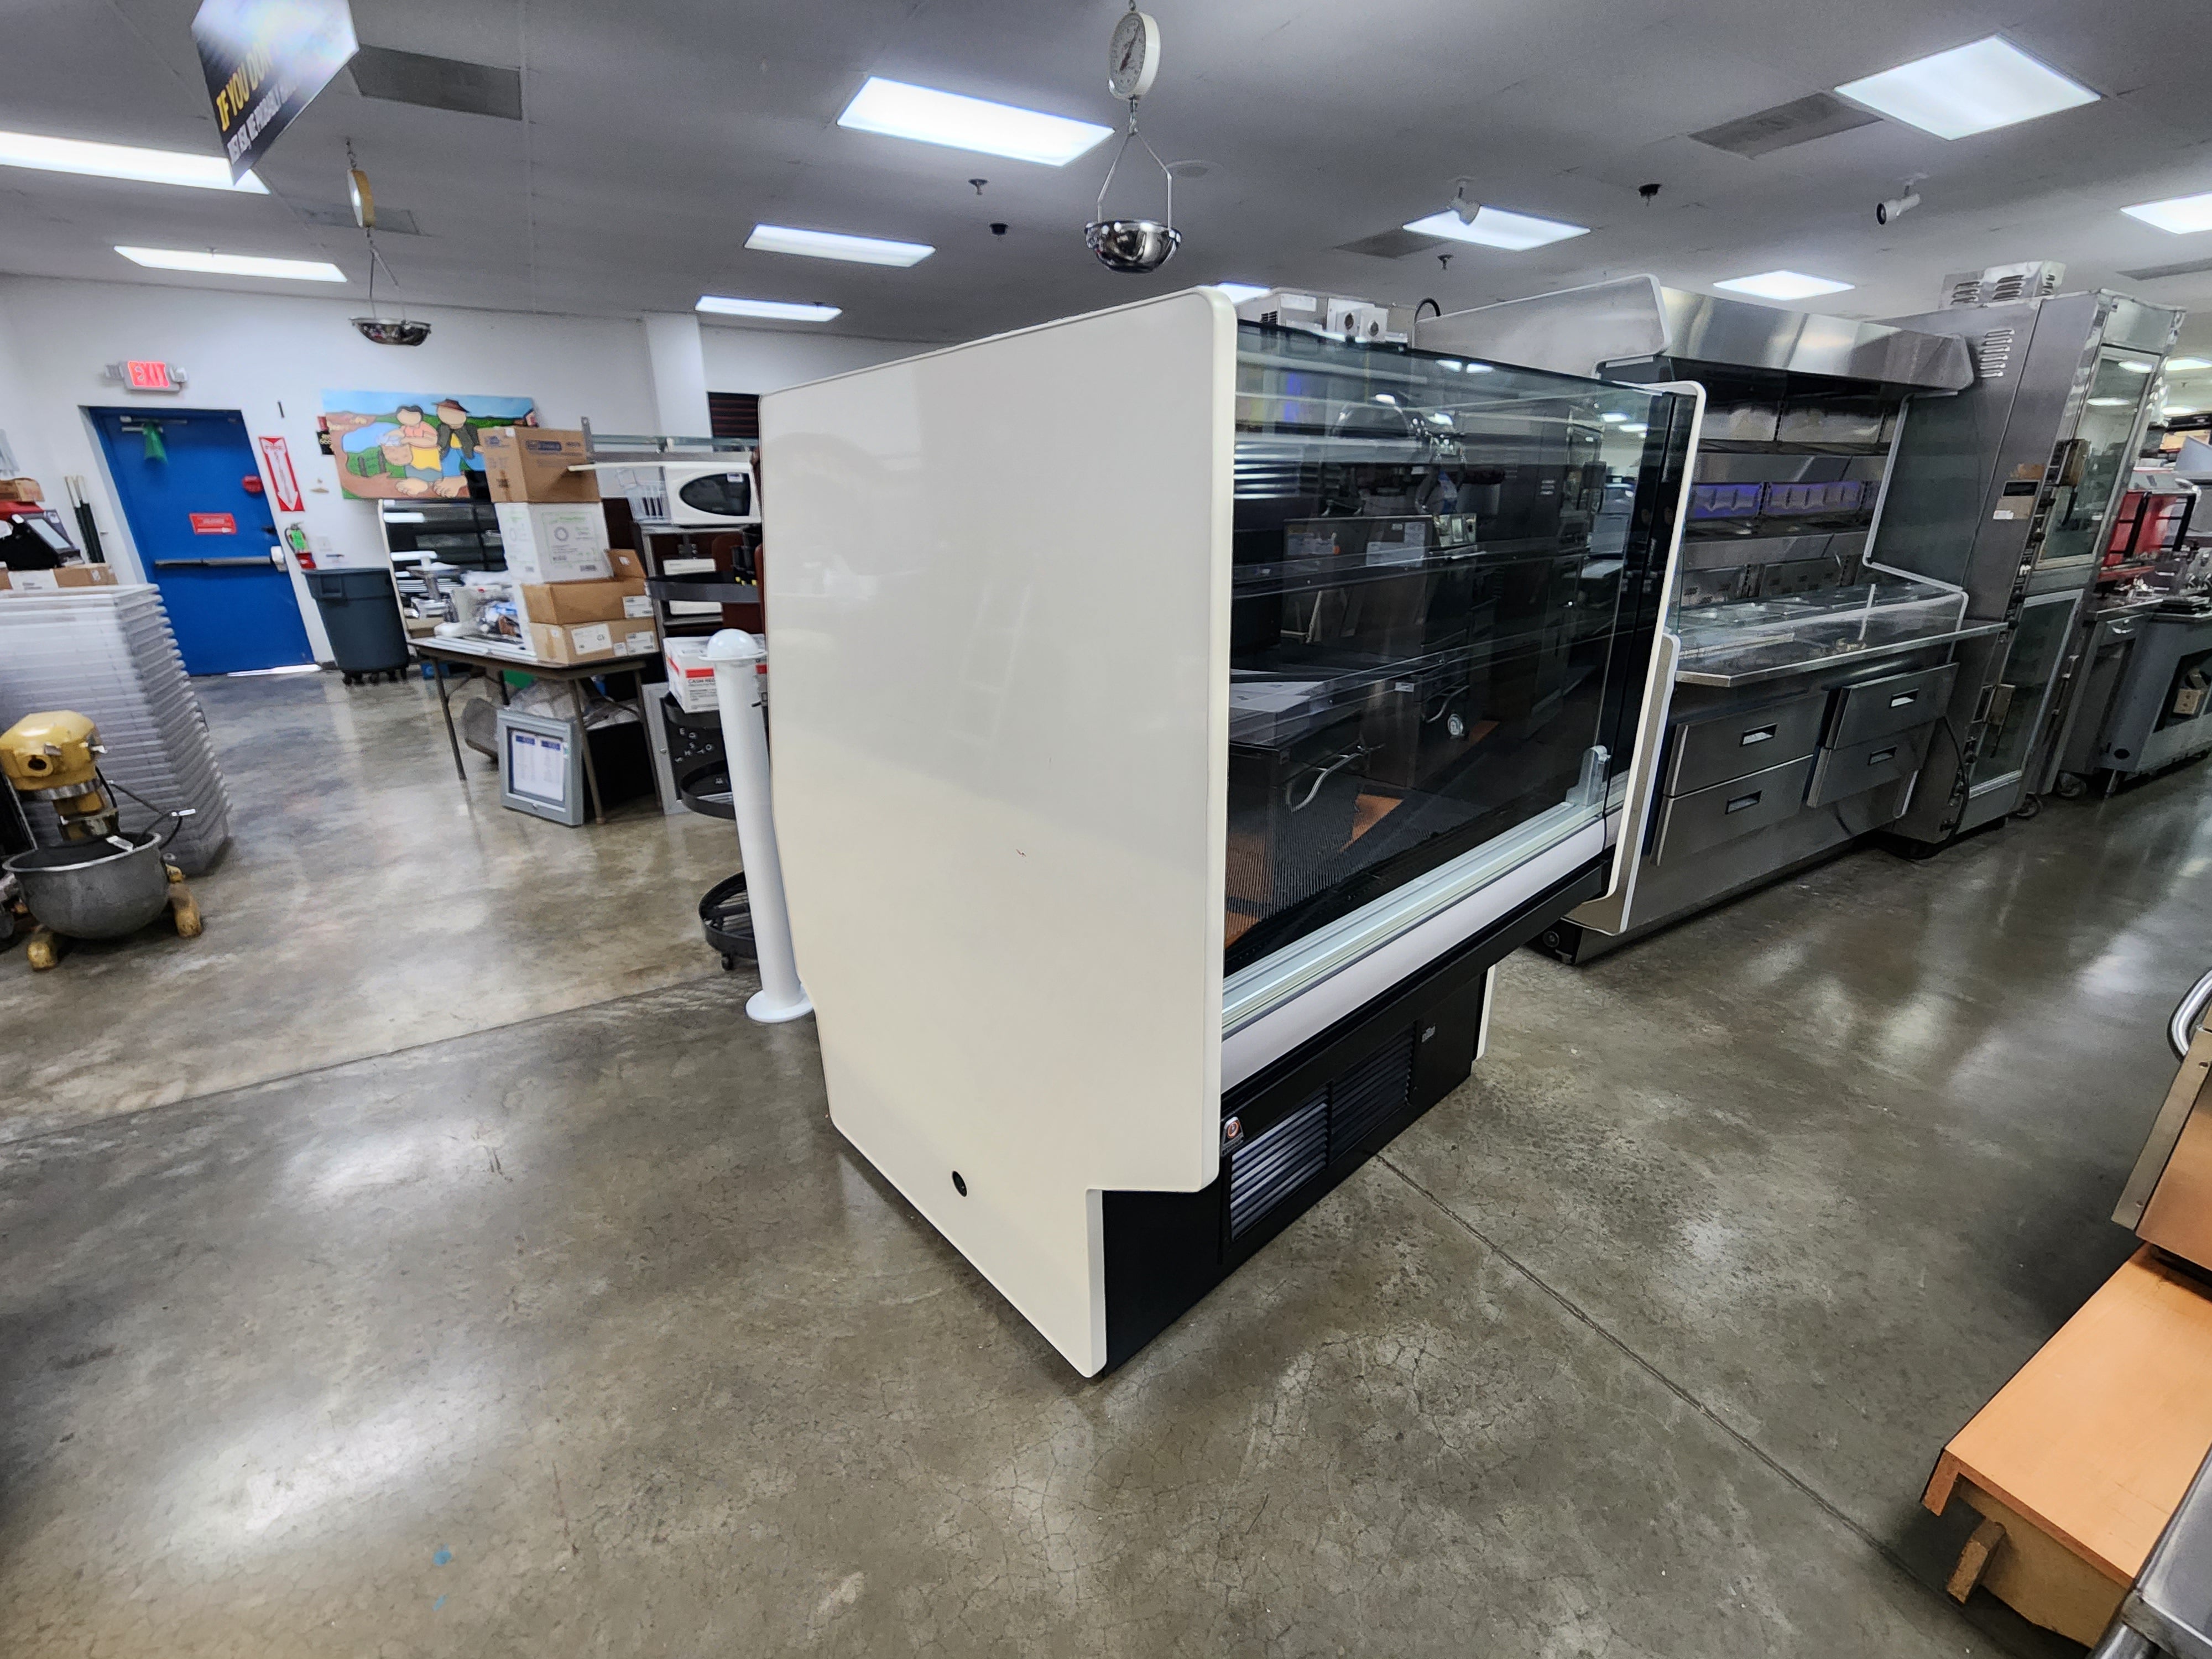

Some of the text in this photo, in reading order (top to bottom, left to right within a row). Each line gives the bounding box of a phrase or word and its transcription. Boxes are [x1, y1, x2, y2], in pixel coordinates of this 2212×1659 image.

[216, 90, 230, 132] IF
[226, 62, 249, 116] YOU
[128, 361, 169, 387] EXIT
